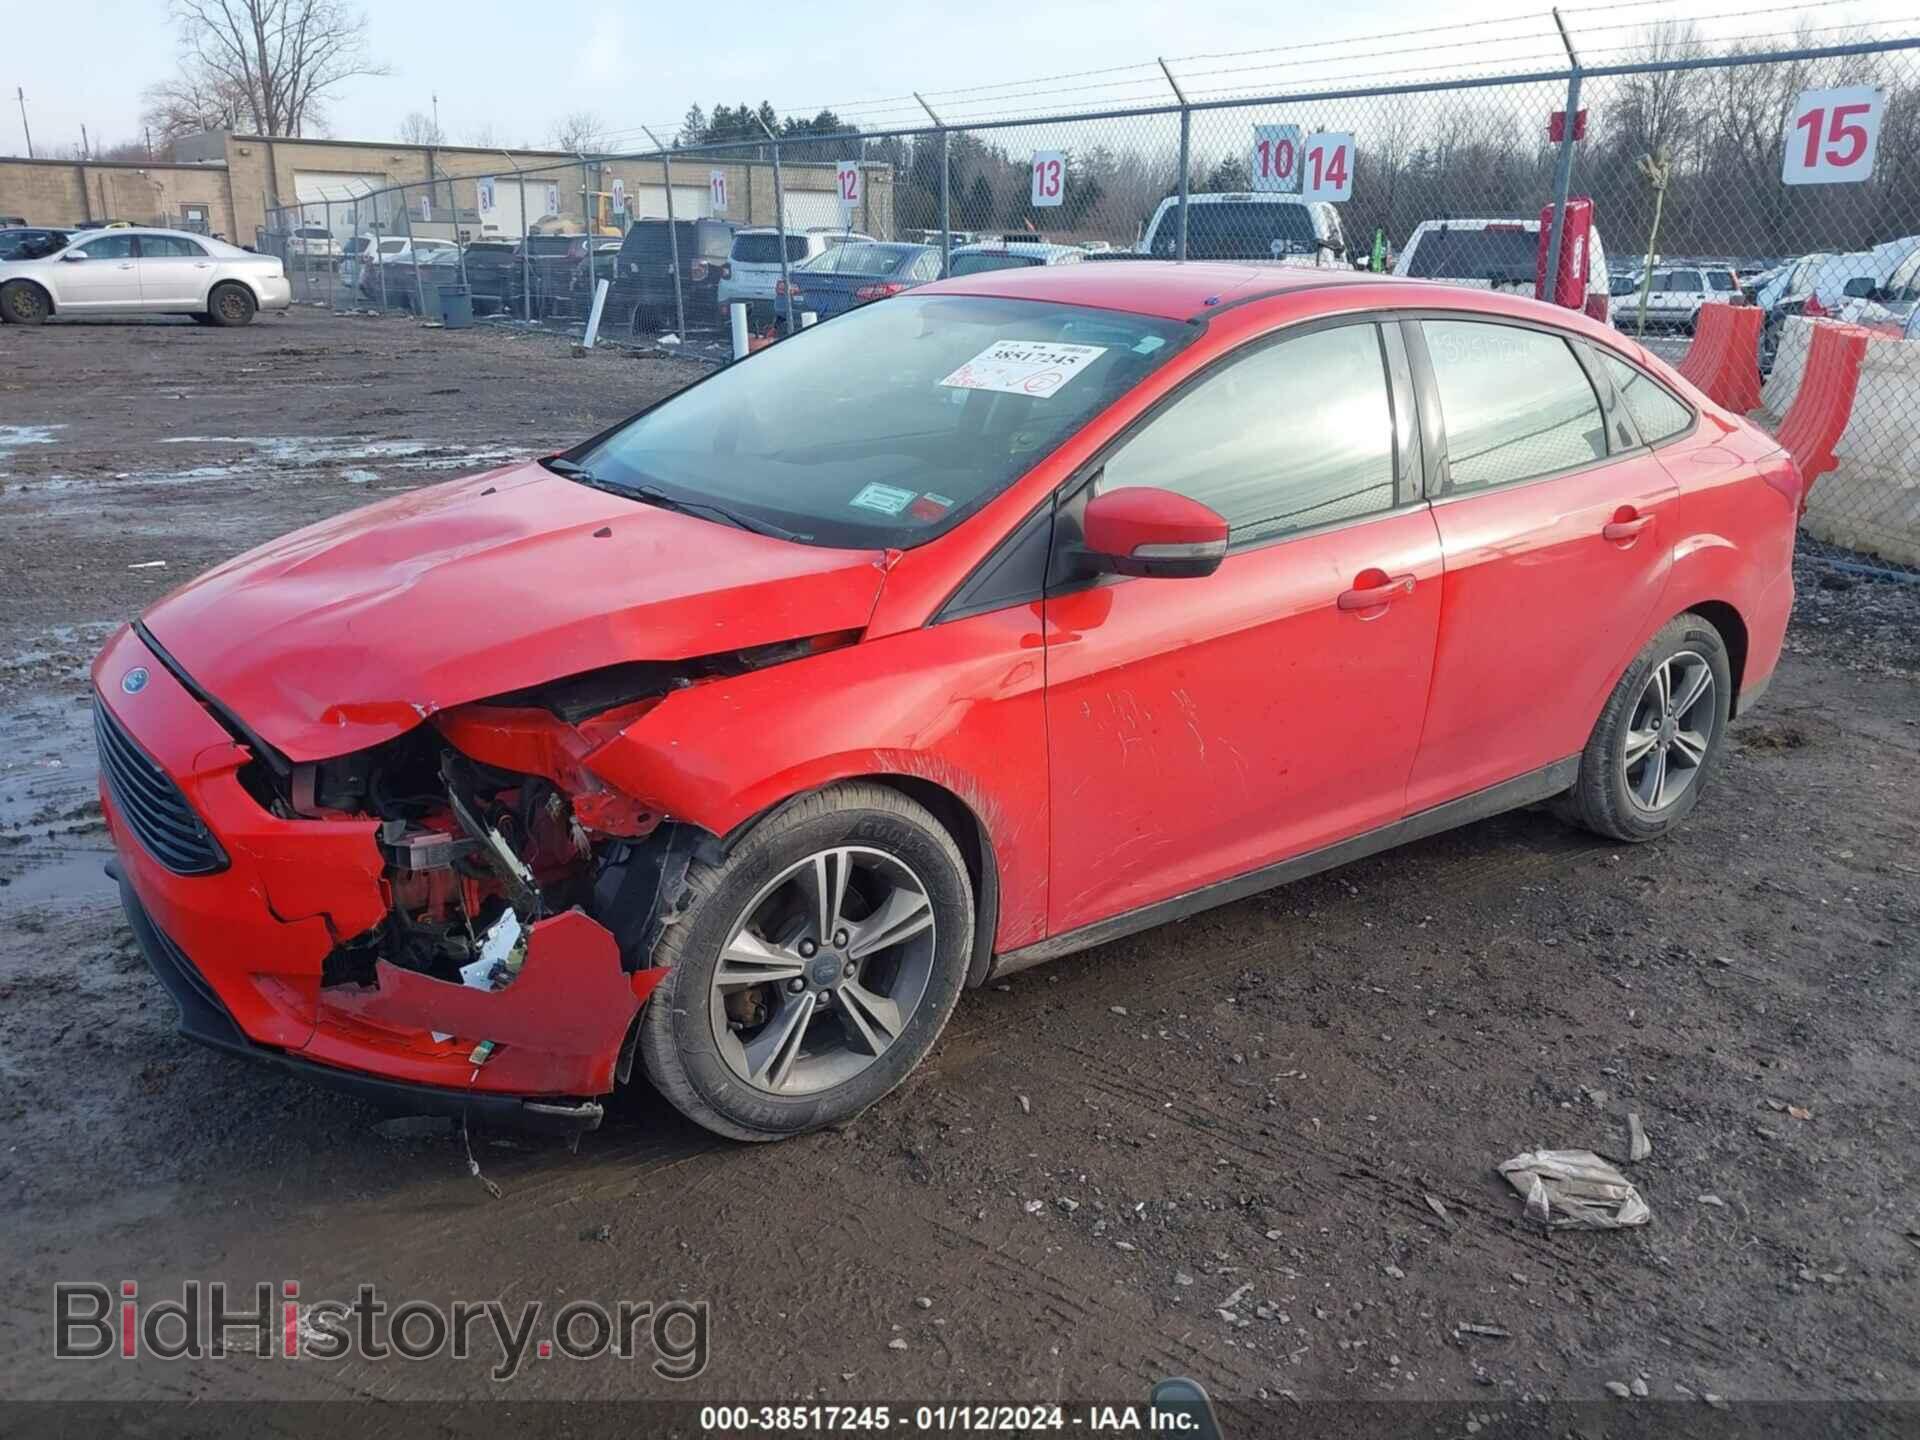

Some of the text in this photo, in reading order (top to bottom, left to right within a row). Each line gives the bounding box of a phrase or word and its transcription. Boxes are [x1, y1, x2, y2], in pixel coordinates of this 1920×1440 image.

[1796, 103, 1871, 168] 15
[1258, 139, 1294, 179] 10
[1308, 145, 1348, 191] 14
[713, 178, 726, 205] 11
[837, 170, 858, 200] 12
[1035, 160, 1061, 197] 13
